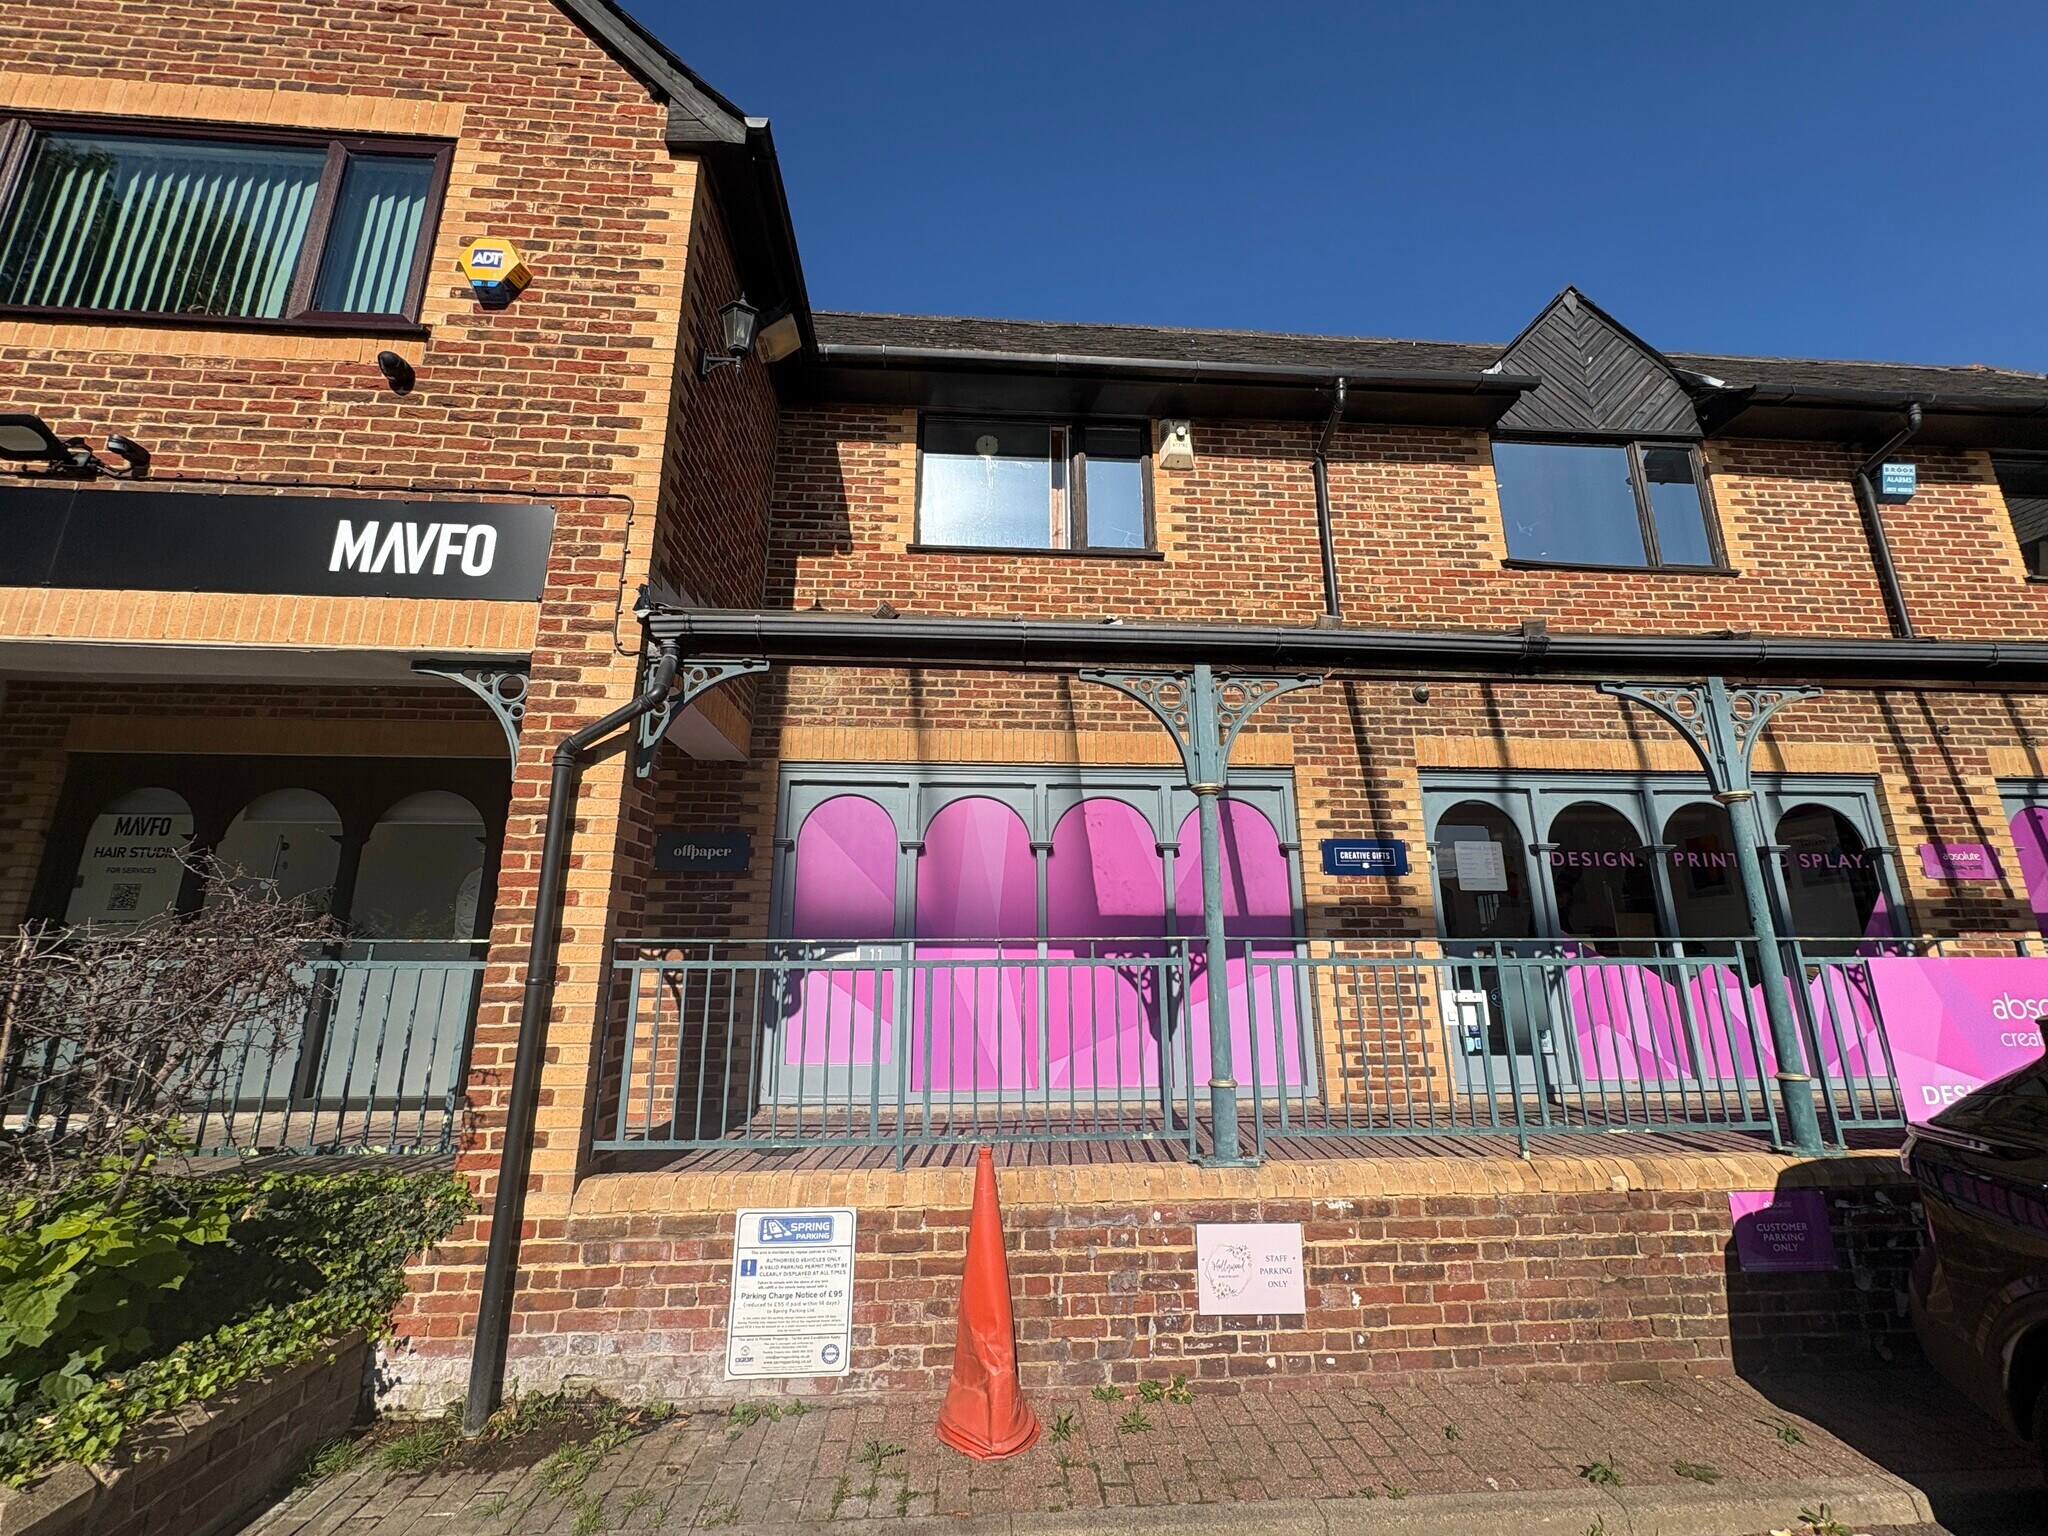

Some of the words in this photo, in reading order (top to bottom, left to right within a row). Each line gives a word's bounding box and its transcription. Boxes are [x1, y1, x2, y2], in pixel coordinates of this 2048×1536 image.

[471, 251, 504, 265] ADT
[329, 519, 498, 577] MAVFO
[114, 816, 172, 836] MAVFO
[94, 846, 126, 858] HAIR
[128, 846, 178, 858] STUDIO
[673, 844, 732, 860] offpaper
[1340, 851, 1370, 860] CREATIVE
[1372, 851, 1390, 860] GIFTS
[870, 948, 882, 960] 11
[790, 1222, 830, 1232] SPRING
[1756, 1222, 1808, 1232] CUSTOMER
[1764, 1232, 1804, 1242] PARKING
[1773, 1243, 1798, 1252] ONLY
[768, 1292, 793, 1300] Charge
